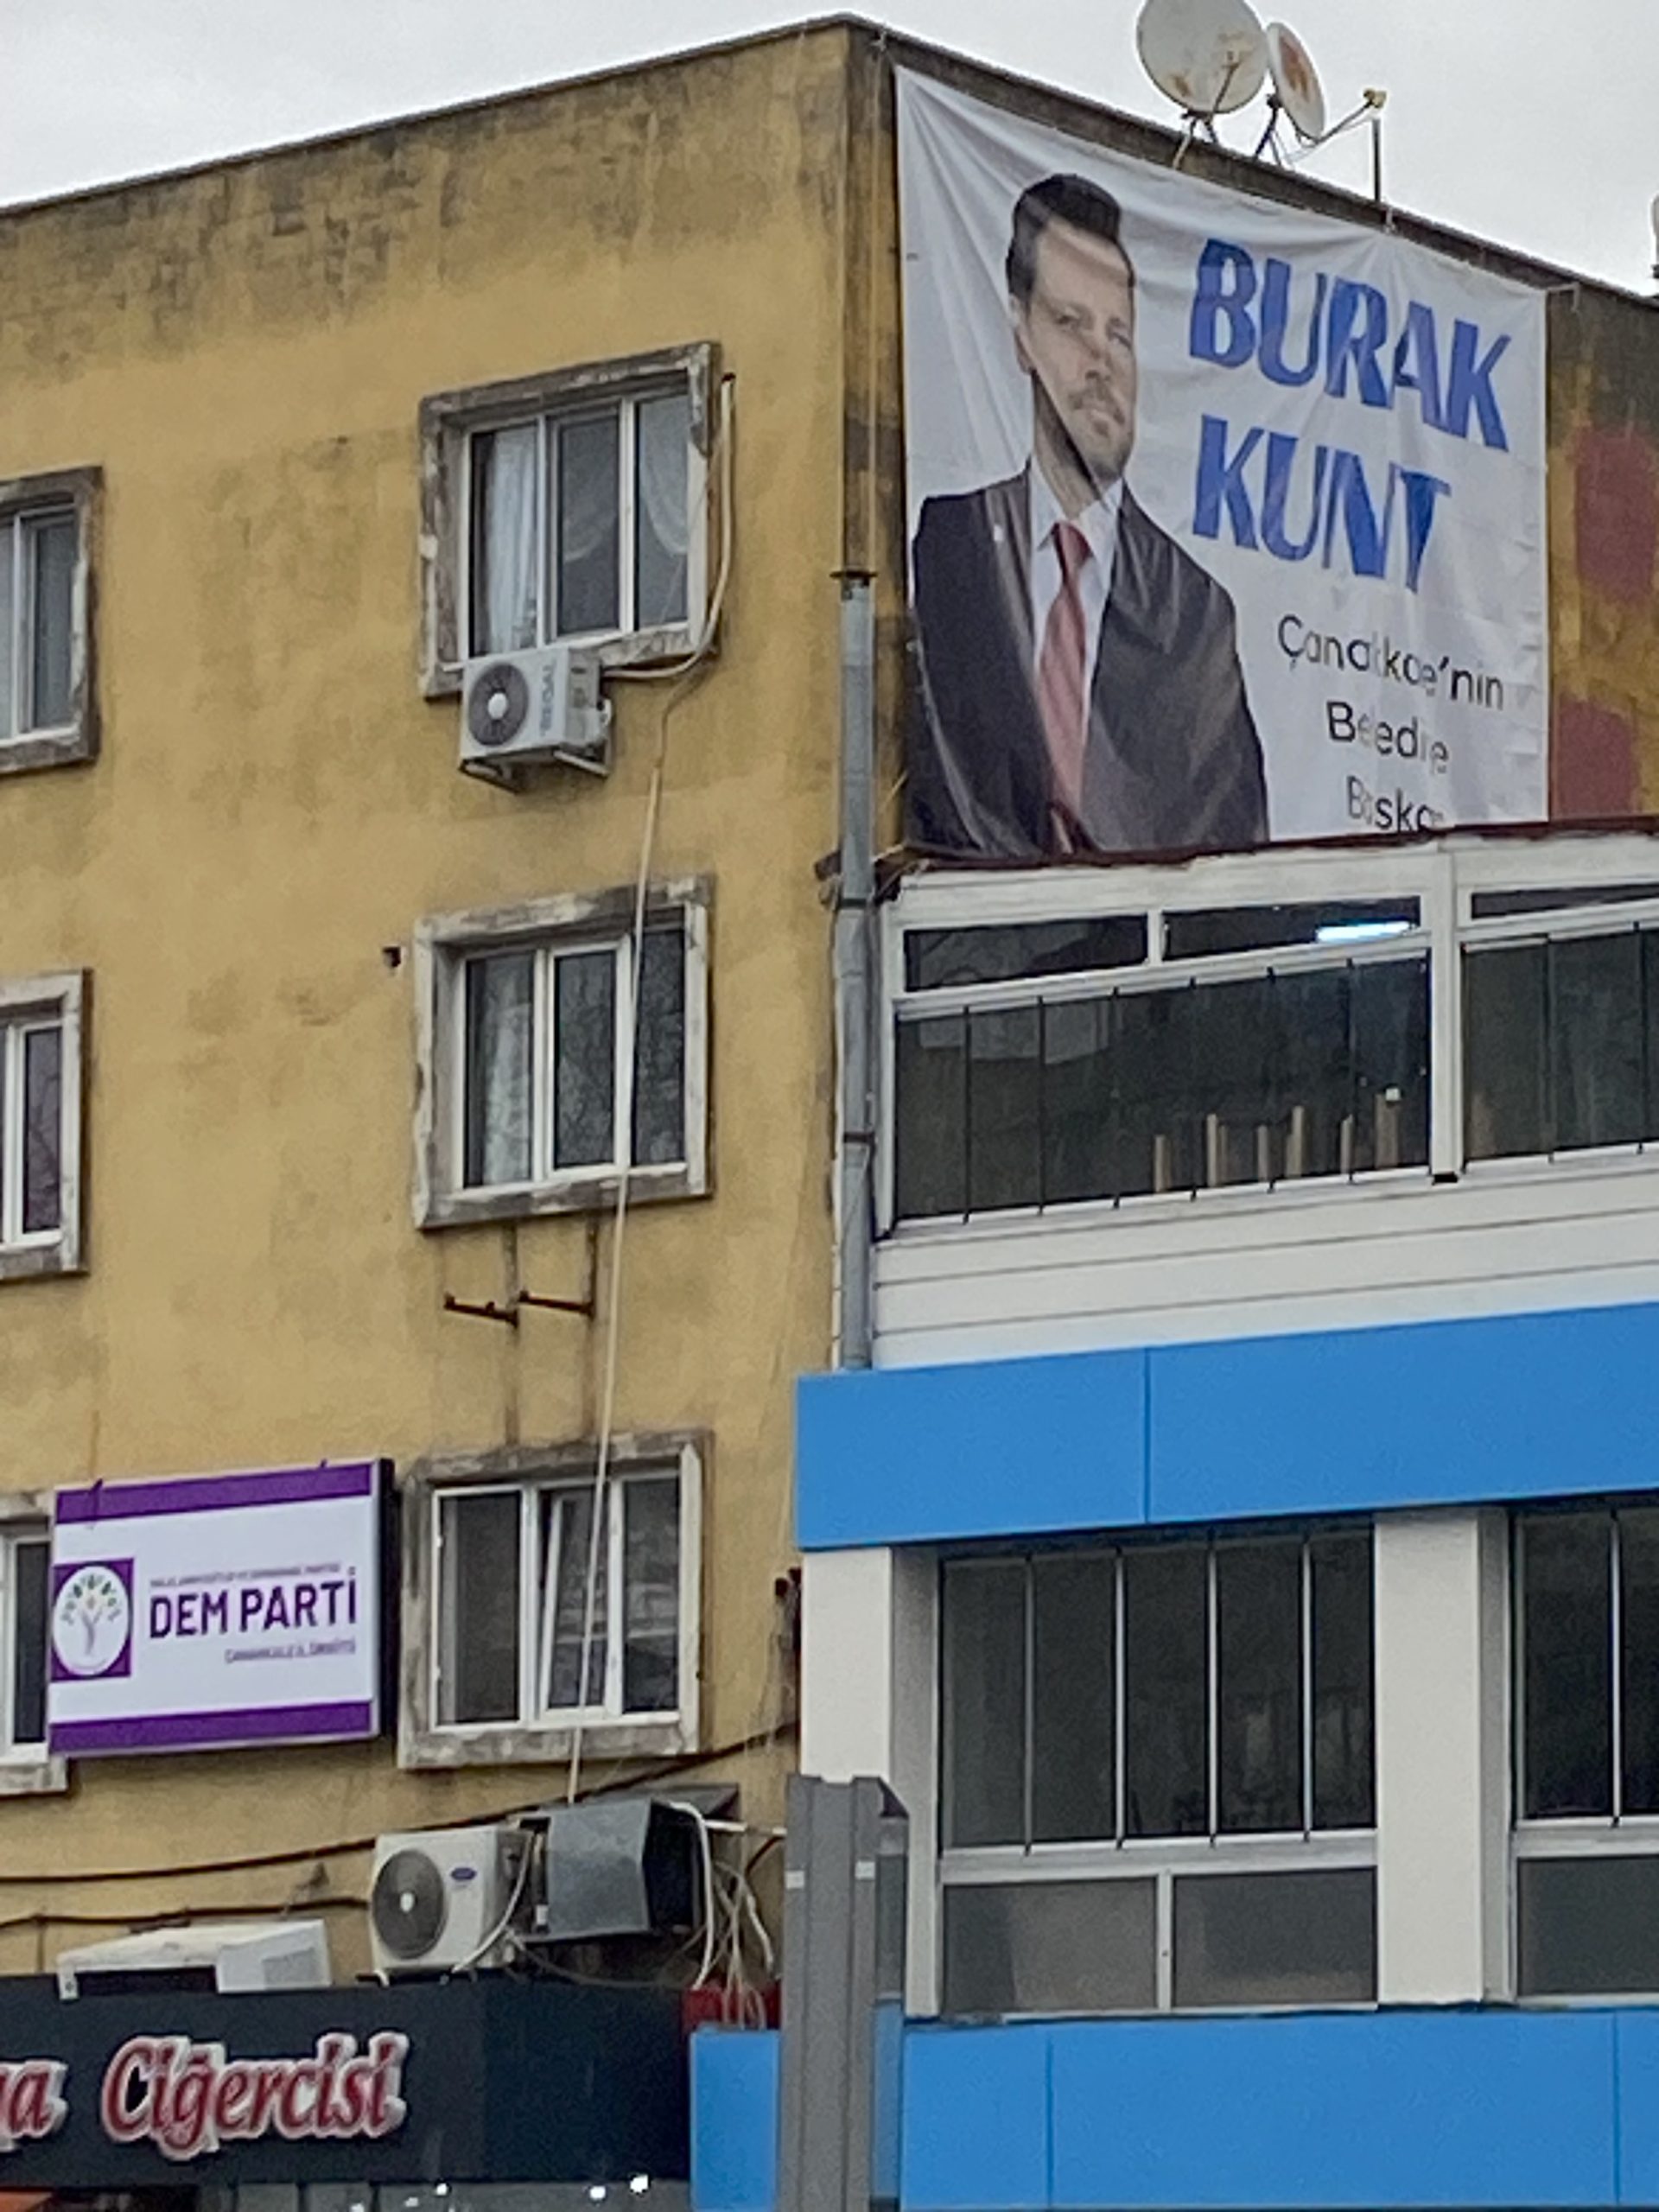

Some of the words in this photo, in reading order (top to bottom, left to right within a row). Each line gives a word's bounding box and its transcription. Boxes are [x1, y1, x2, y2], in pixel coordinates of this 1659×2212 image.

[1189, 238, 1512, 454] BURAK
[1192, 414, 1452, 595] KUNT
[149, 1589, 229, 1639] DEM
[238, 1566, 358, 1634] PARTİ
